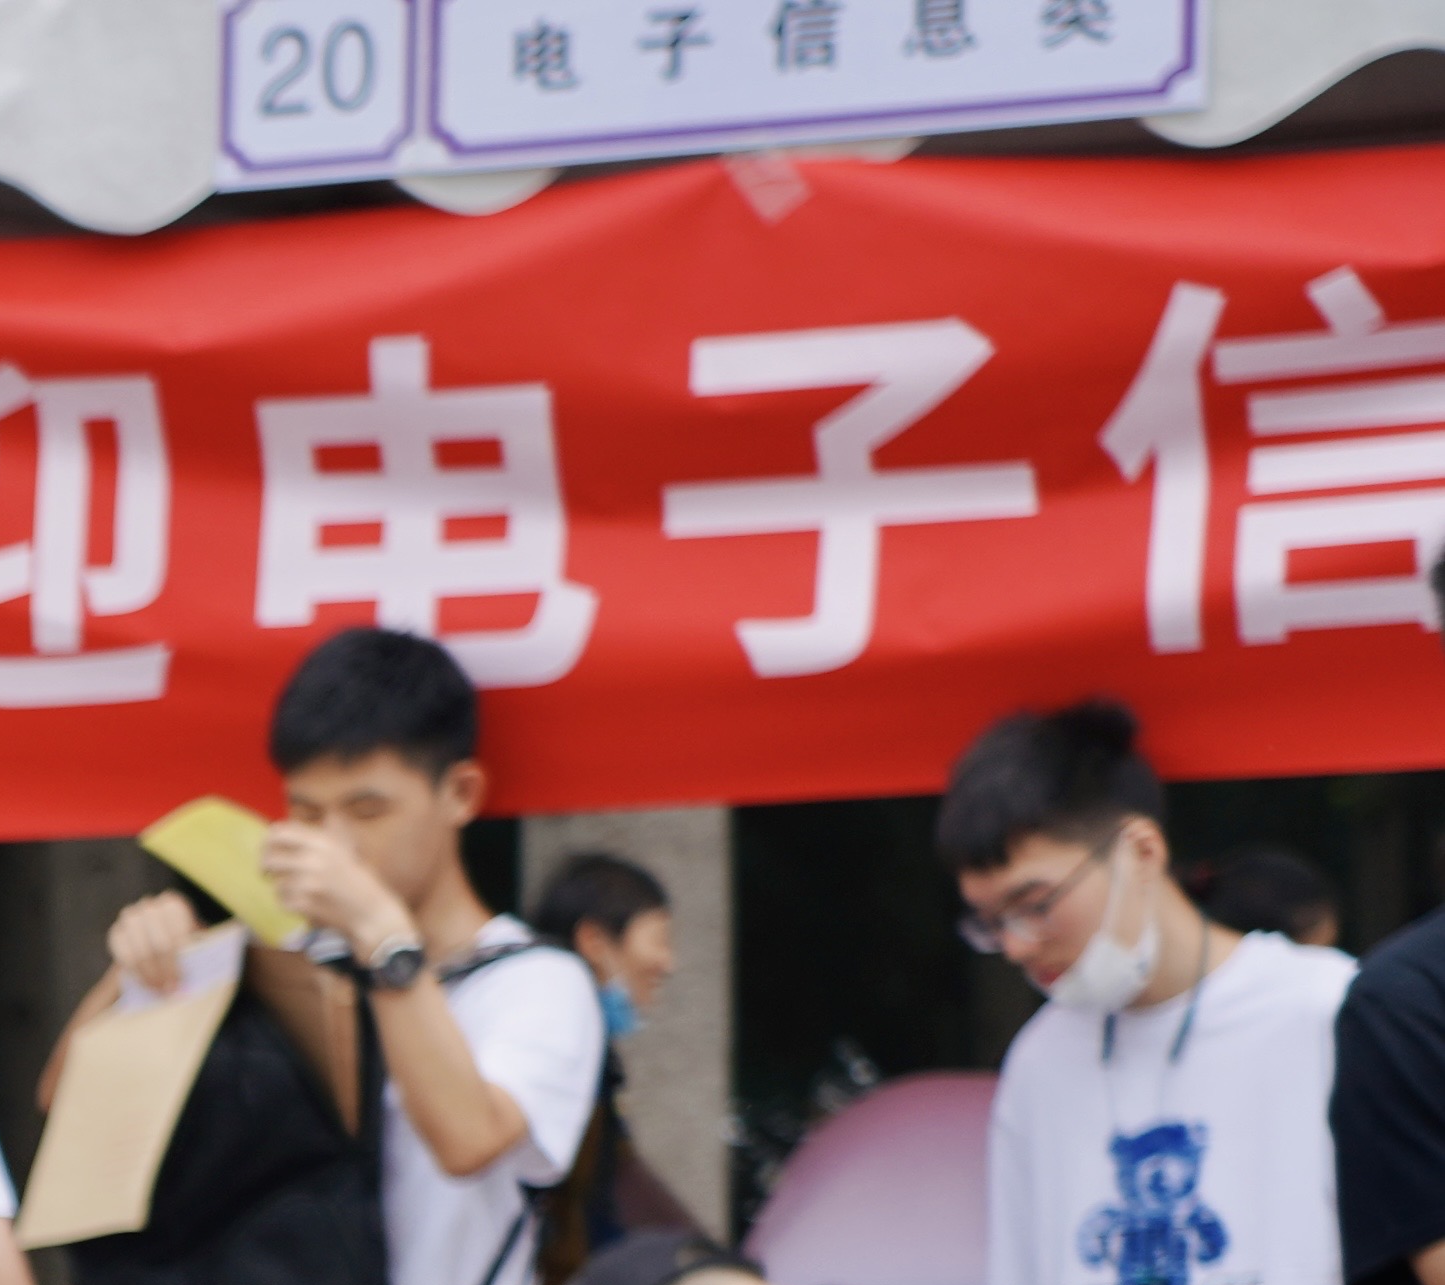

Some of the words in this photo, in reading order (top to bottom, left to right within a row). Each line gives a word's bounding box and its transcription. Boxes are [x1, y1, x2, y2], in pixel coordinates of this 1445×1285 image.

[258, 24, 376, 118] 20
[510, 0, 1116, 92] 电子信息类
